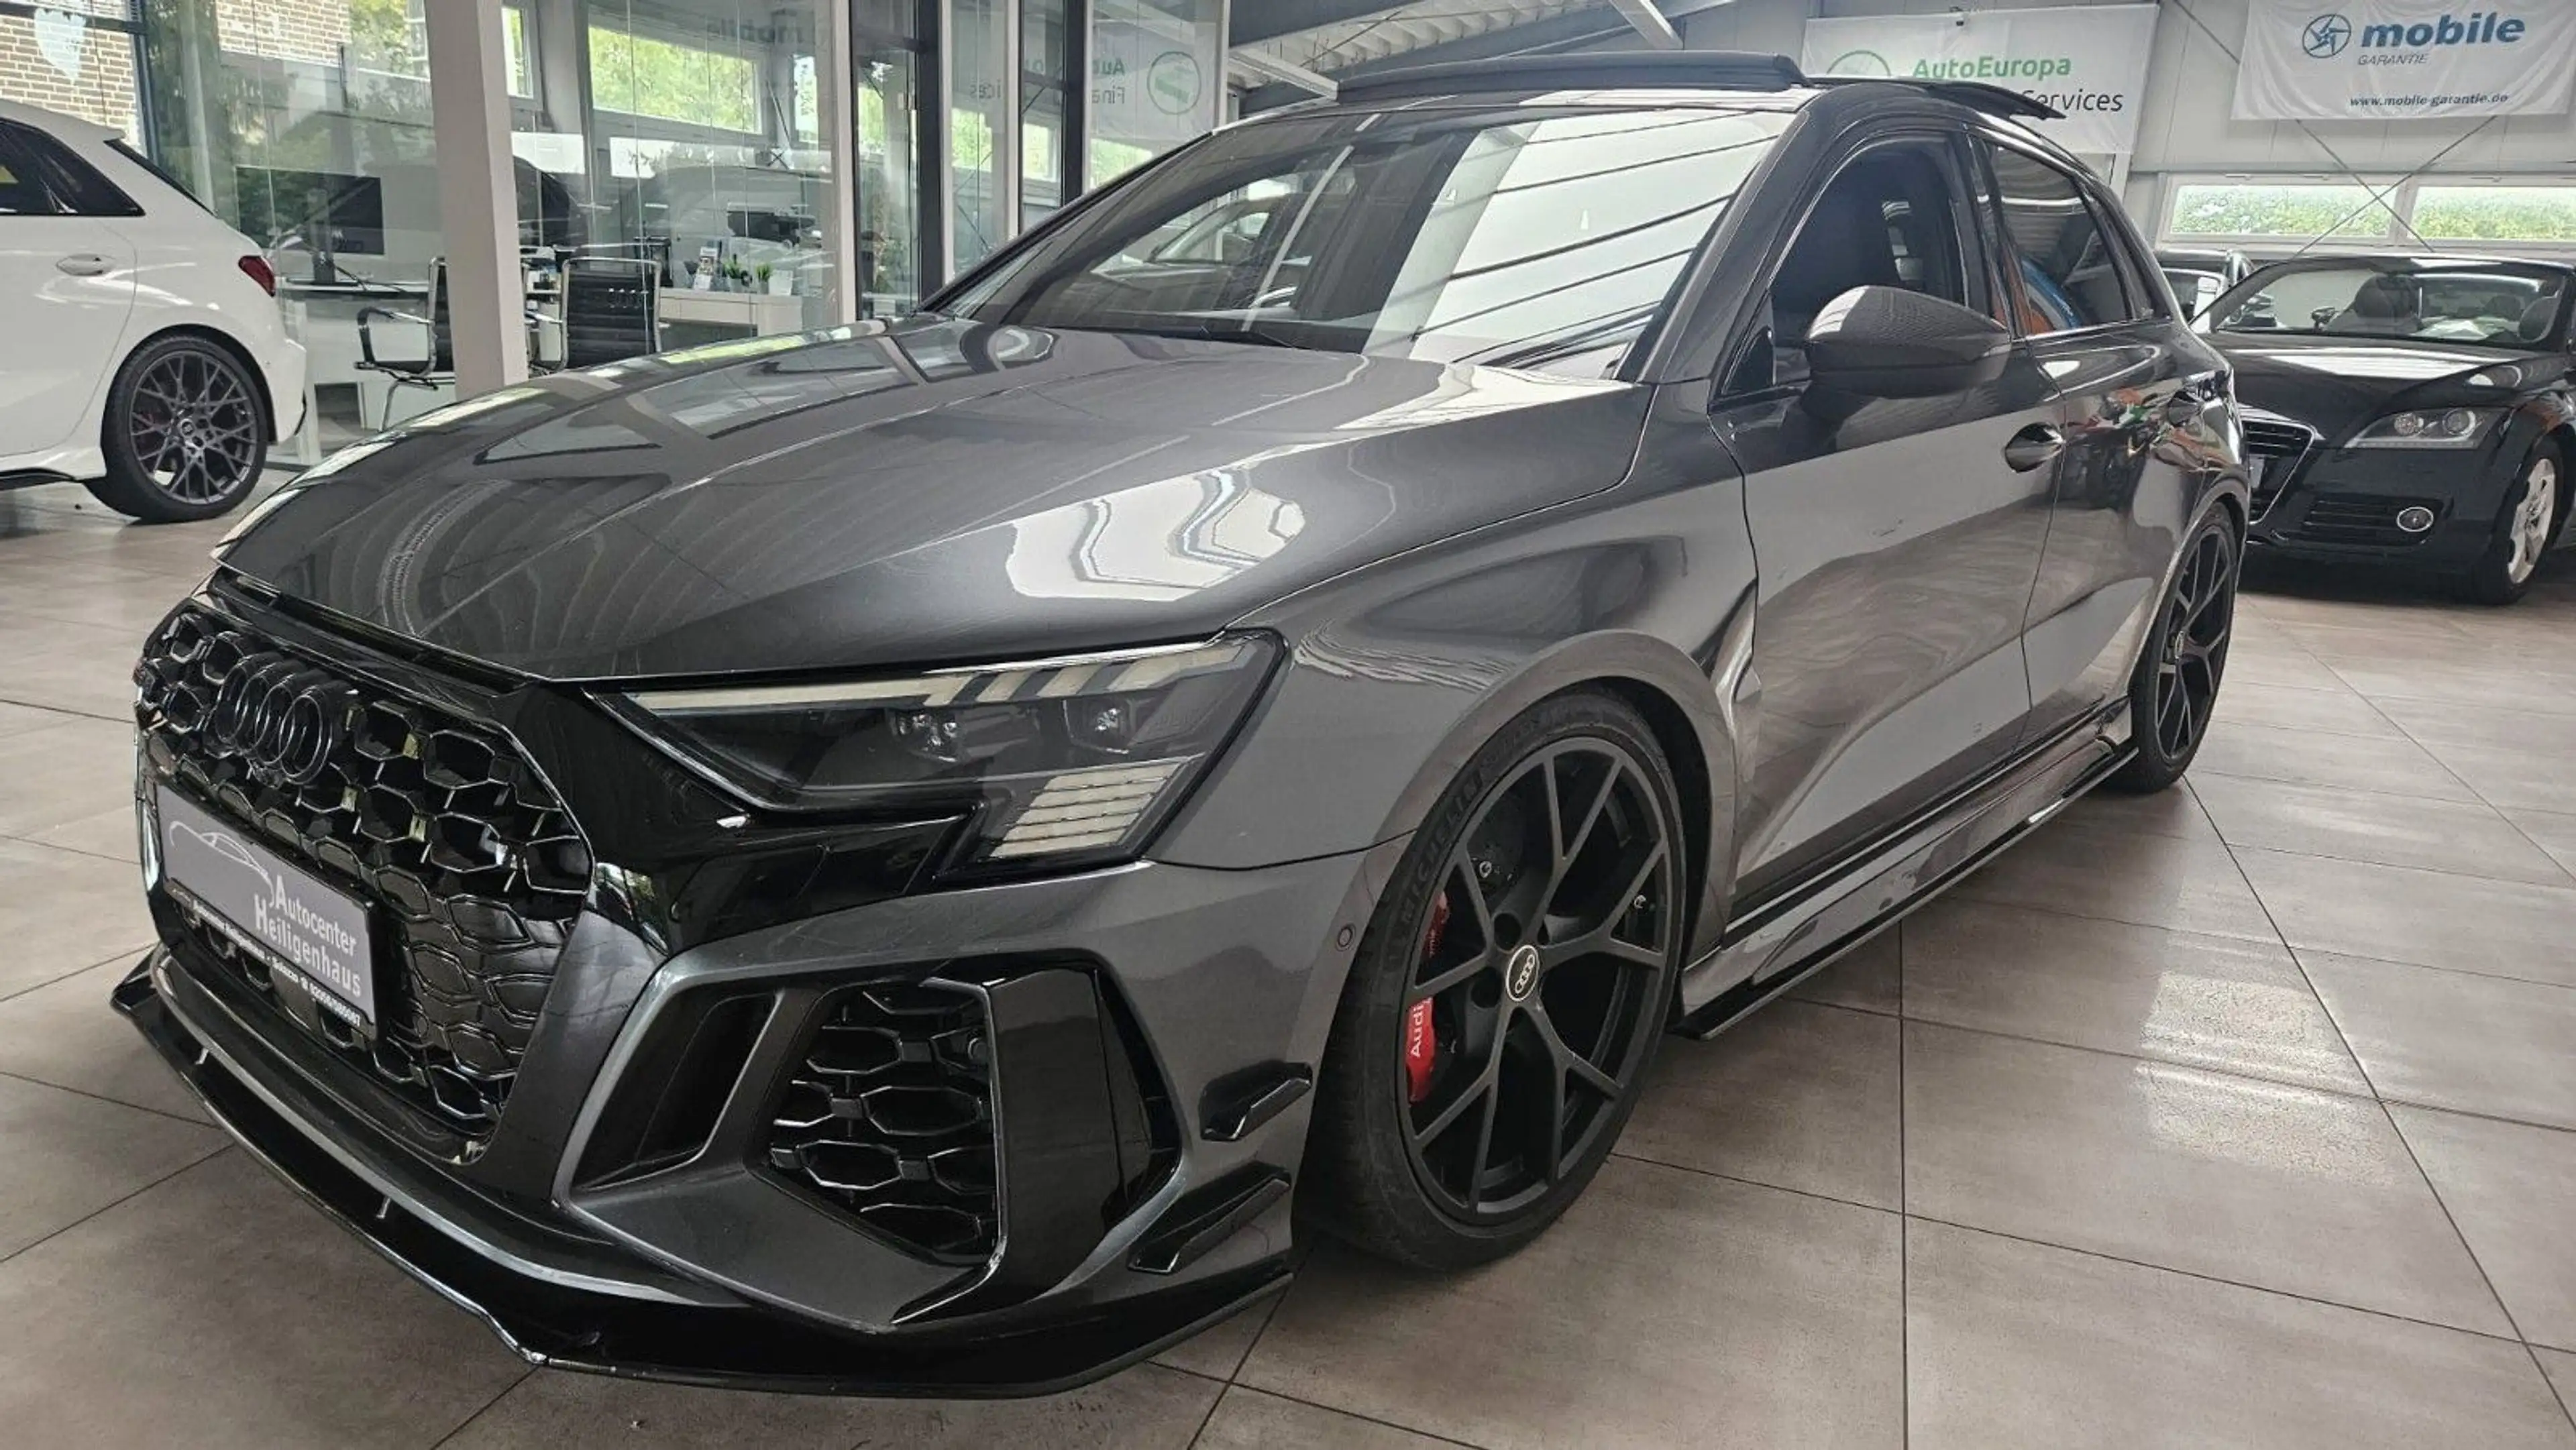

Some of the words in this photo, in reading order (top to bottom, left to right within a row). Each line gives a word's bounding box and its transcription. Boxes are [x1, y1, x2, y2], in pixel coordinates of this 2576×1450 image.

[2361, 11, 2526, 48] mobile
[1912, 56, 2072, 81] AutoEuropa
[2358, 53, 2428, 66] GARANTIE
[2350, 93, 2508, 107] www.mobile-garantie.de
[274, 874, 357, 957] Autocenter
[254, 893, 362, 998] Heiligenhaus
[1410, 1005, 1425, 1058] Audi
